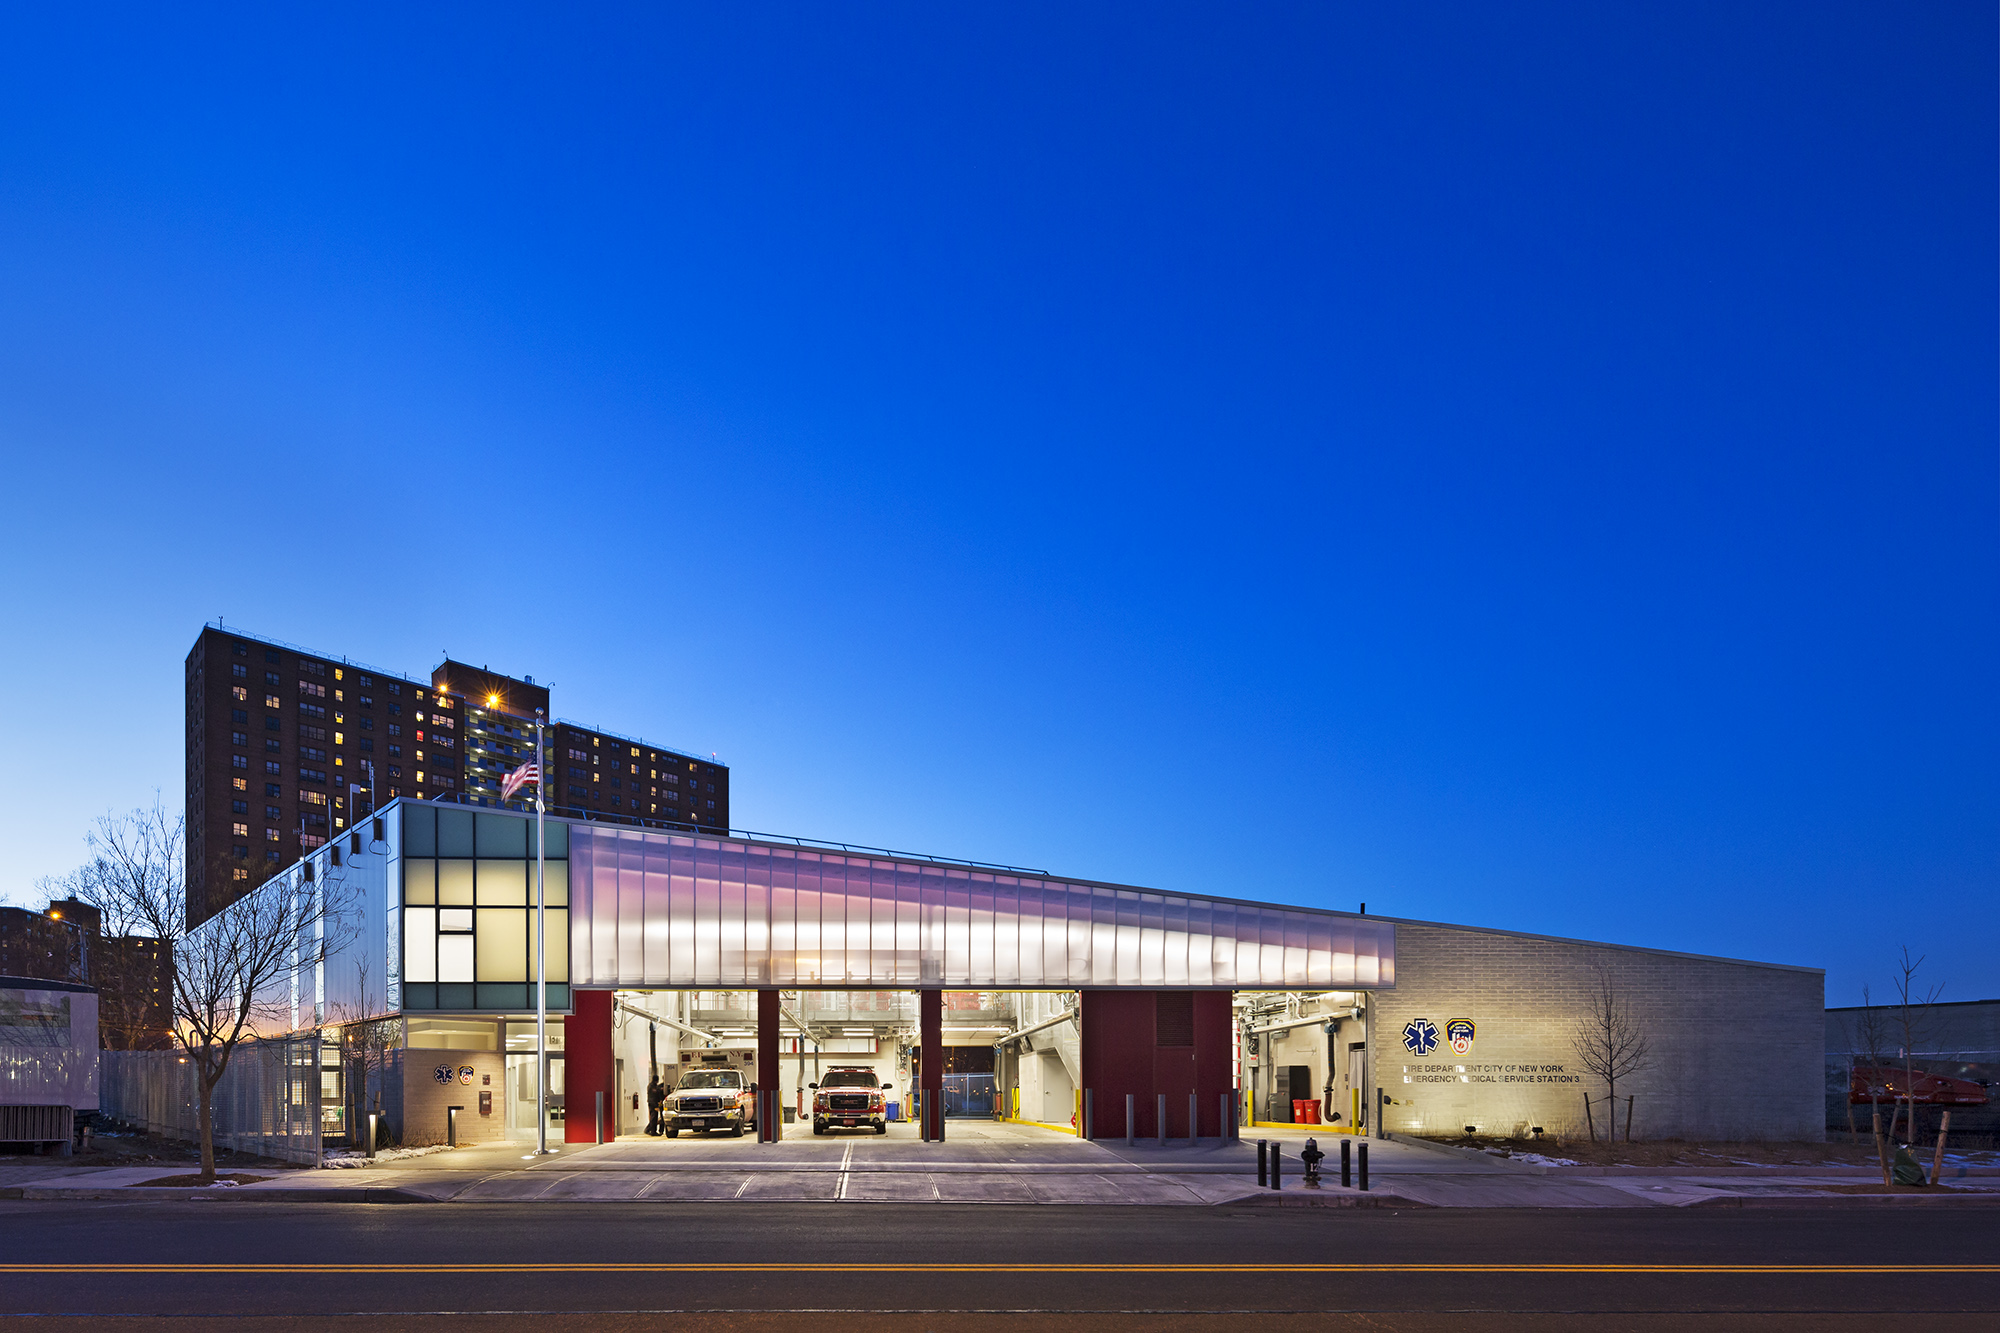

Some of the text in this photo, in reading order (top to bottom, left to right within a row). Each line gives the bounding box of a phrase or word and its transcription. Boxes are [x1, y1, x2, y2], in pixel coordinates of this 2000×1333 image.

[1403, 1065, 1422, 1073] FIRE
[1424, 1065, 1482, 1073] DEPARTMENT
[1403, 1075, 1457, 1083] EMERGENCY
[1459, 1075, 1496, 1083] MEDICAL
[1310, 1163, 1319, 1172] 12
